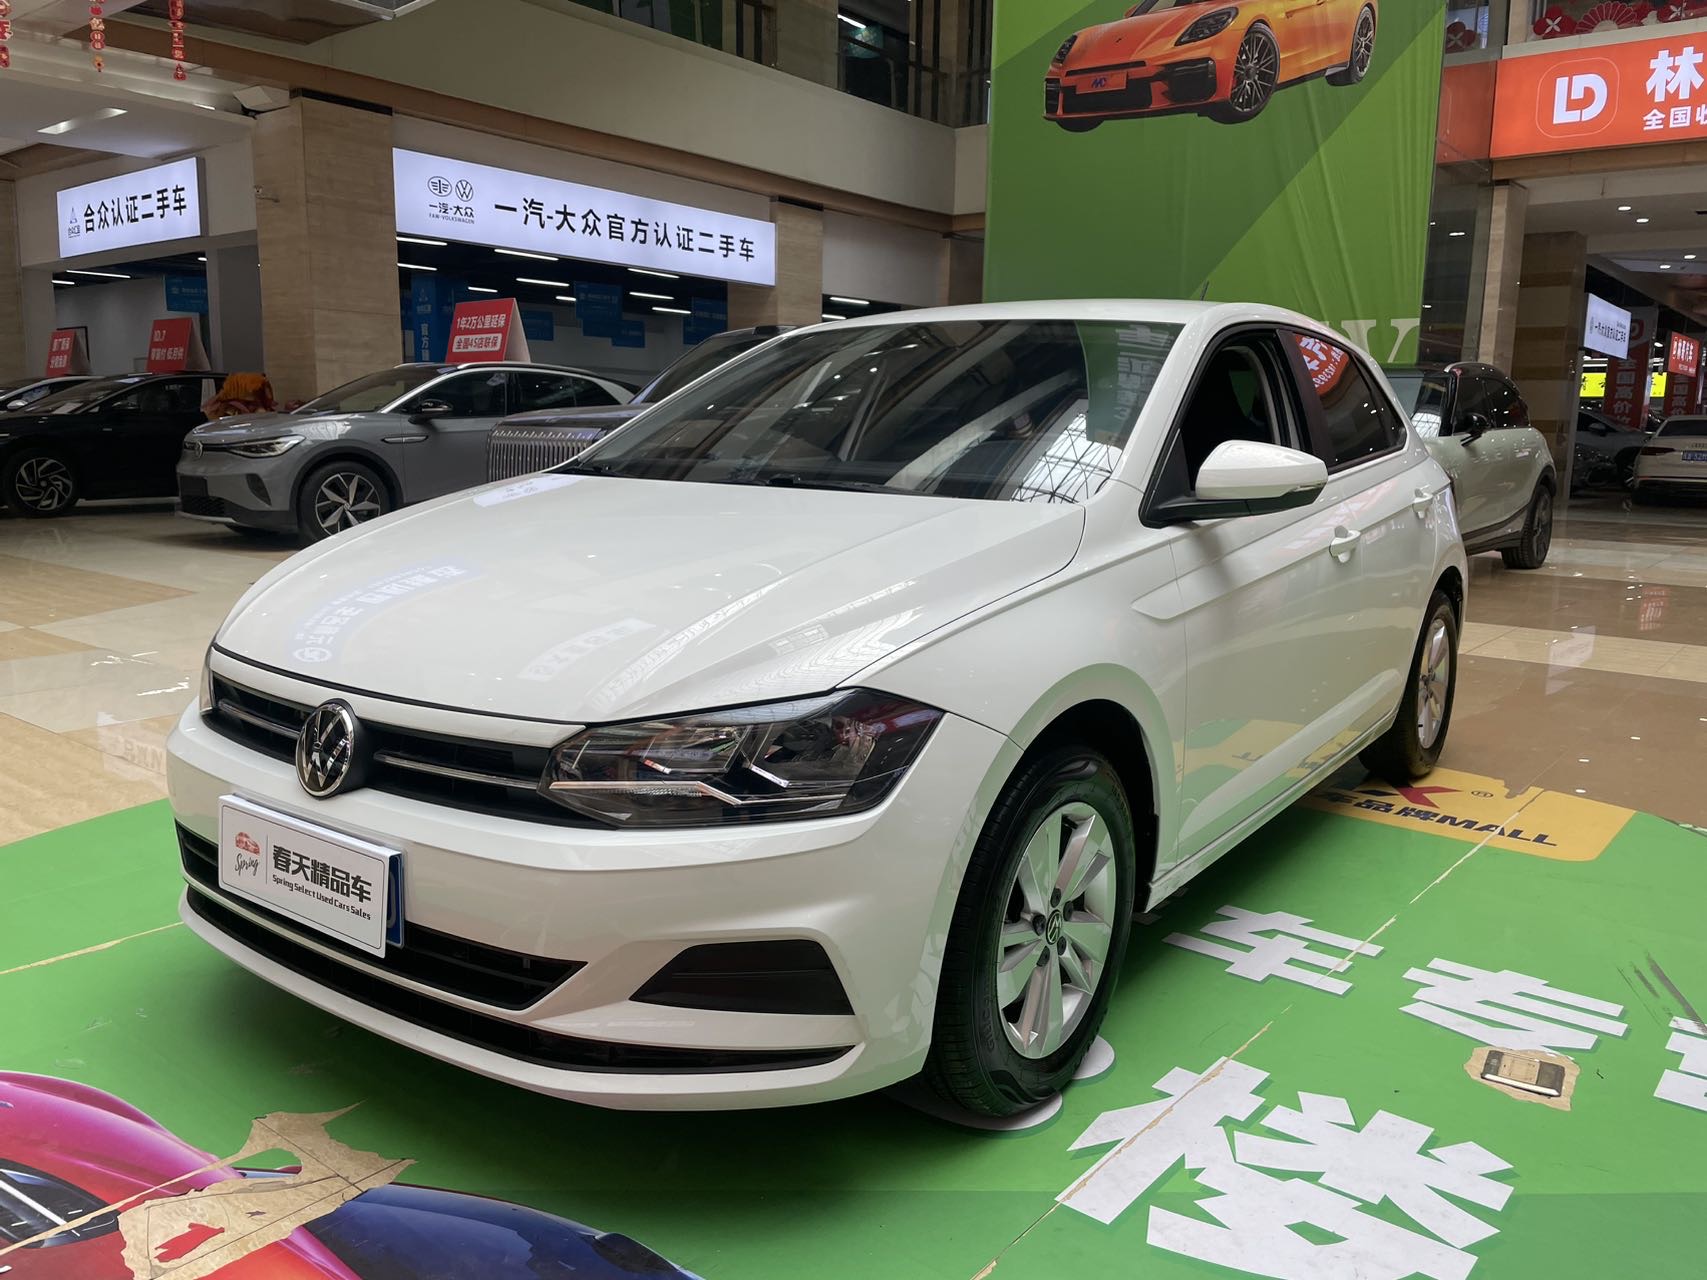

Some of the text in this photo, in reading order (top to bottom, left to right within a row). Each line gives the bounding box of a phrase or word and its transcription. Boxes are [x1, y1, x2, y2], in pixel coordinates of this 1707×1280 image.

[1646, 46, 1704, 102] 林
[84, 184, 187, 233] 合众认证二手车
[455, 336, 498, 350] 全国4S店联保
[456, 313, 506, 331] 1年2万公里延保
[235, 853, 259, 876] Spring
[273, 844, 372, 903] 春天精品车
[272, 874, 371, 920] Spring Select Used Cars Sales
